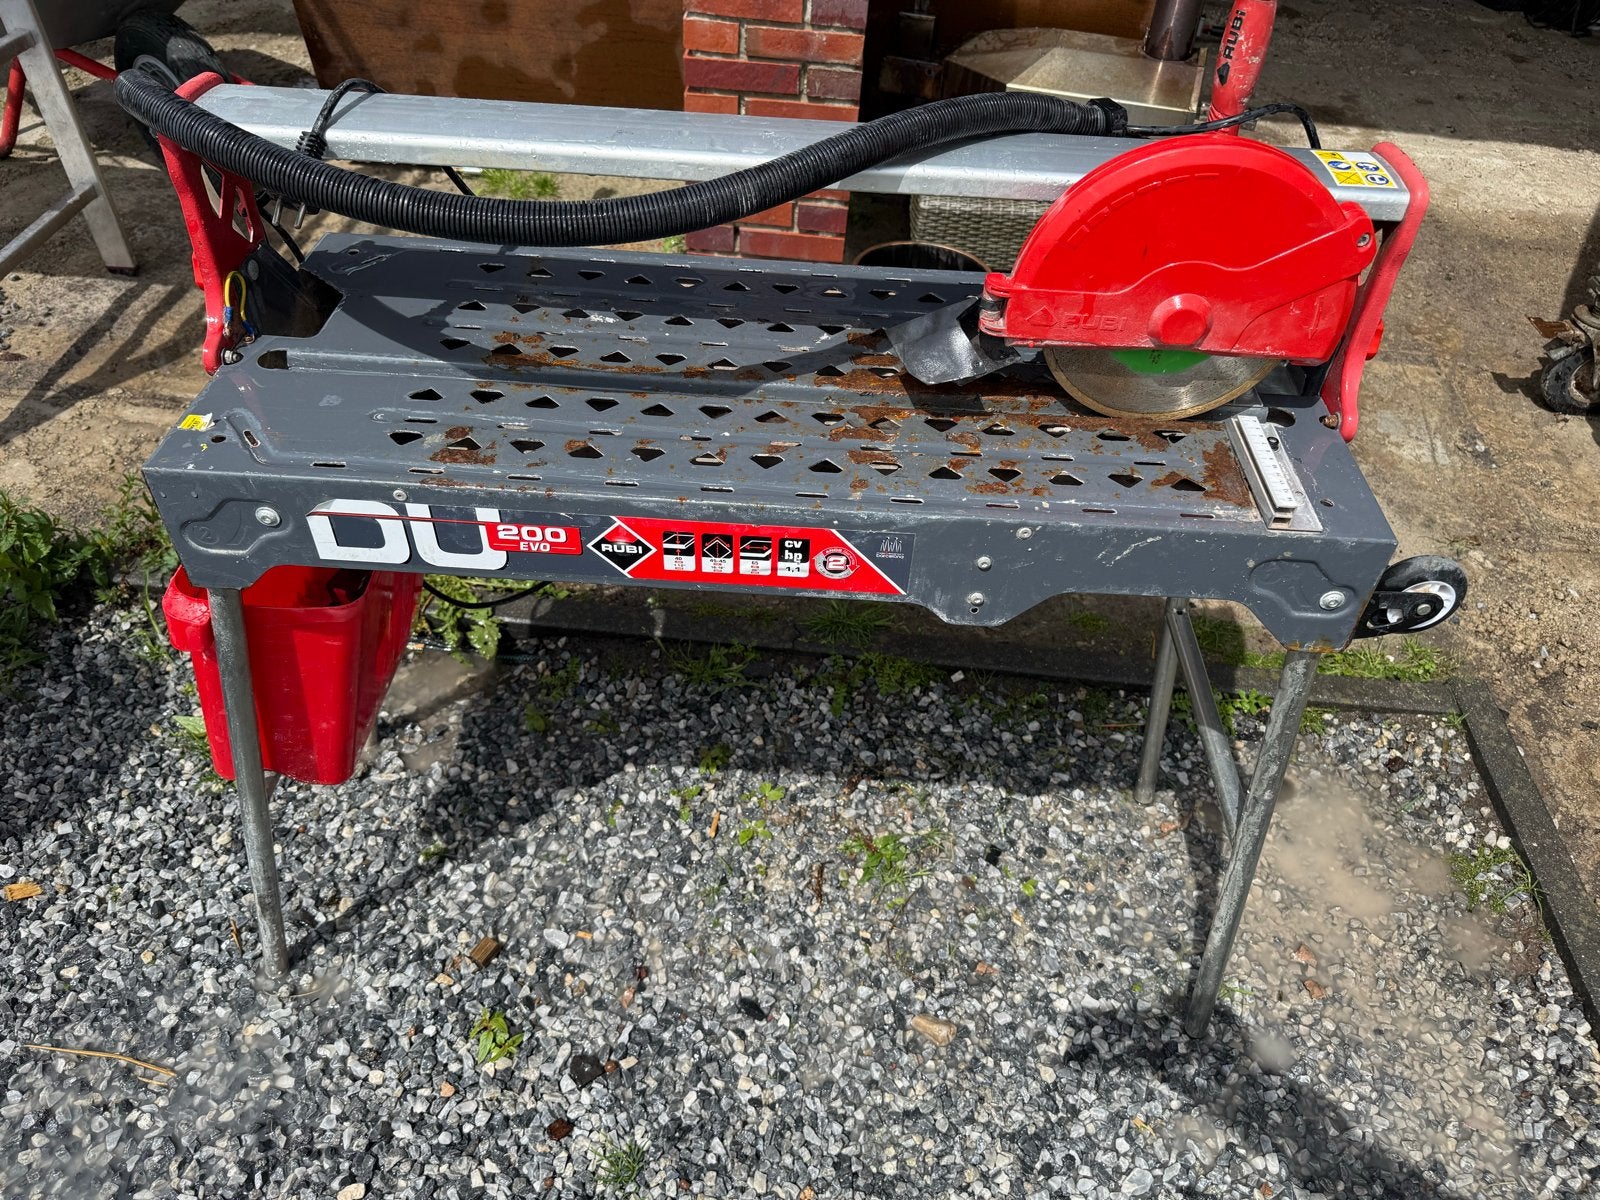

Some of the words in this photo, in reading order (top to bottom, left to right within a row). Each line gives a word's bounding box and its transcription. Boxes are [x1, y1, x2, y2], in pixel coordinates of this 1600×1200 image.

[1223, 9, 1246, 60] RUBI
[1062, 312, 1128, 332] RUBI
[306, 498, 508, 570] DU
[497, 524, 567, 543] 200
[519, 541, 551, 552] EVO
[601, 543, 643, 555] RUBI
[827, 555, 847, 570] 2
